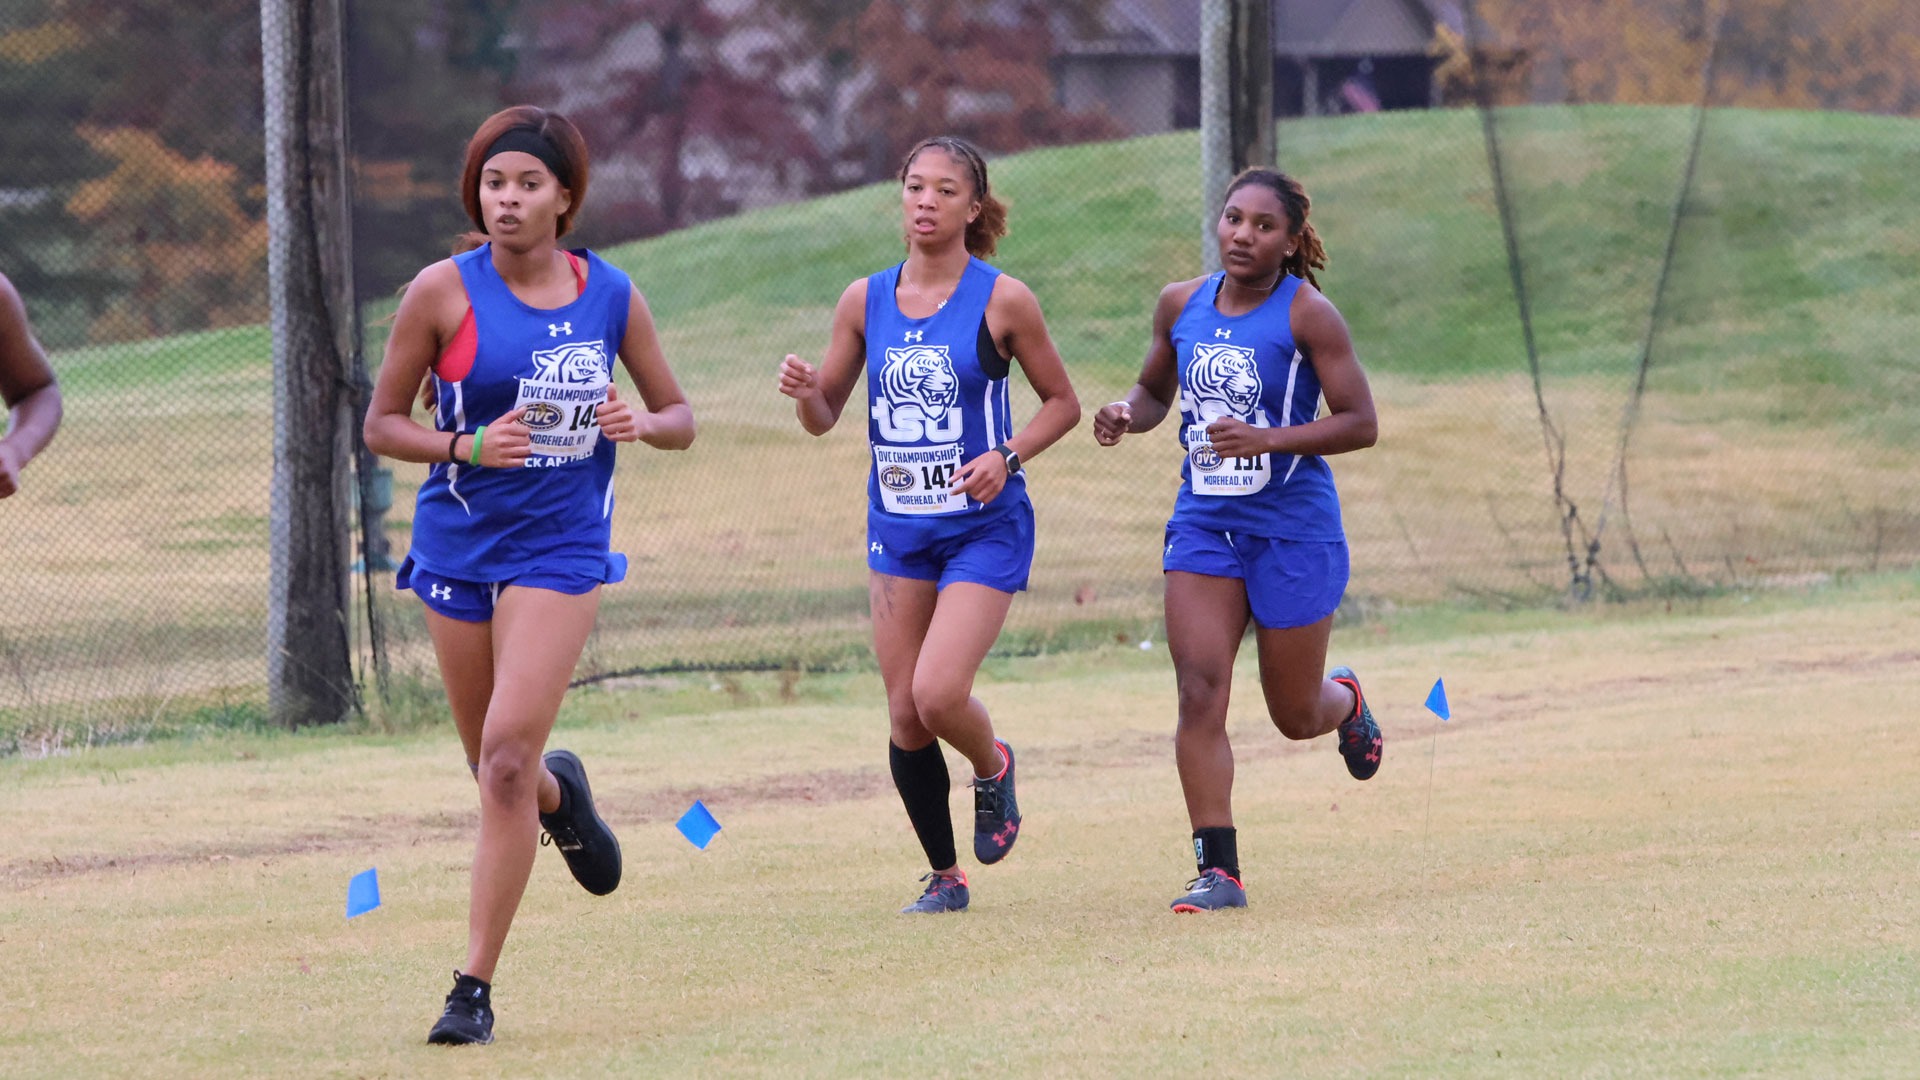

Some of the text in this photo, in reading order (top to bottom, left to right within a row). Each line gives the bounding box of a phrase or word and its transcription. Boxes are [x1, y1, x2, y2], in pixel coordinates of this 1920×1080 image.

[522, 384, 608, 401] OVC CHAMPIONSH
[523, 410, 554, 423] OVC
[577, 435, 587, 445] KY
[1190, 430, 1204, 442] OVC
[879, 451, 893, 462] OVC
[893, 448, 957, 463] CHAMPIONSHIP
[1196, 453, 1216, 465] OVC
[887, 472, 907, 485] OVC
[921, 463, 955, 490] 147
[1243, 475, 1253, 485] KY
[937, 493, 948, 503] KY
